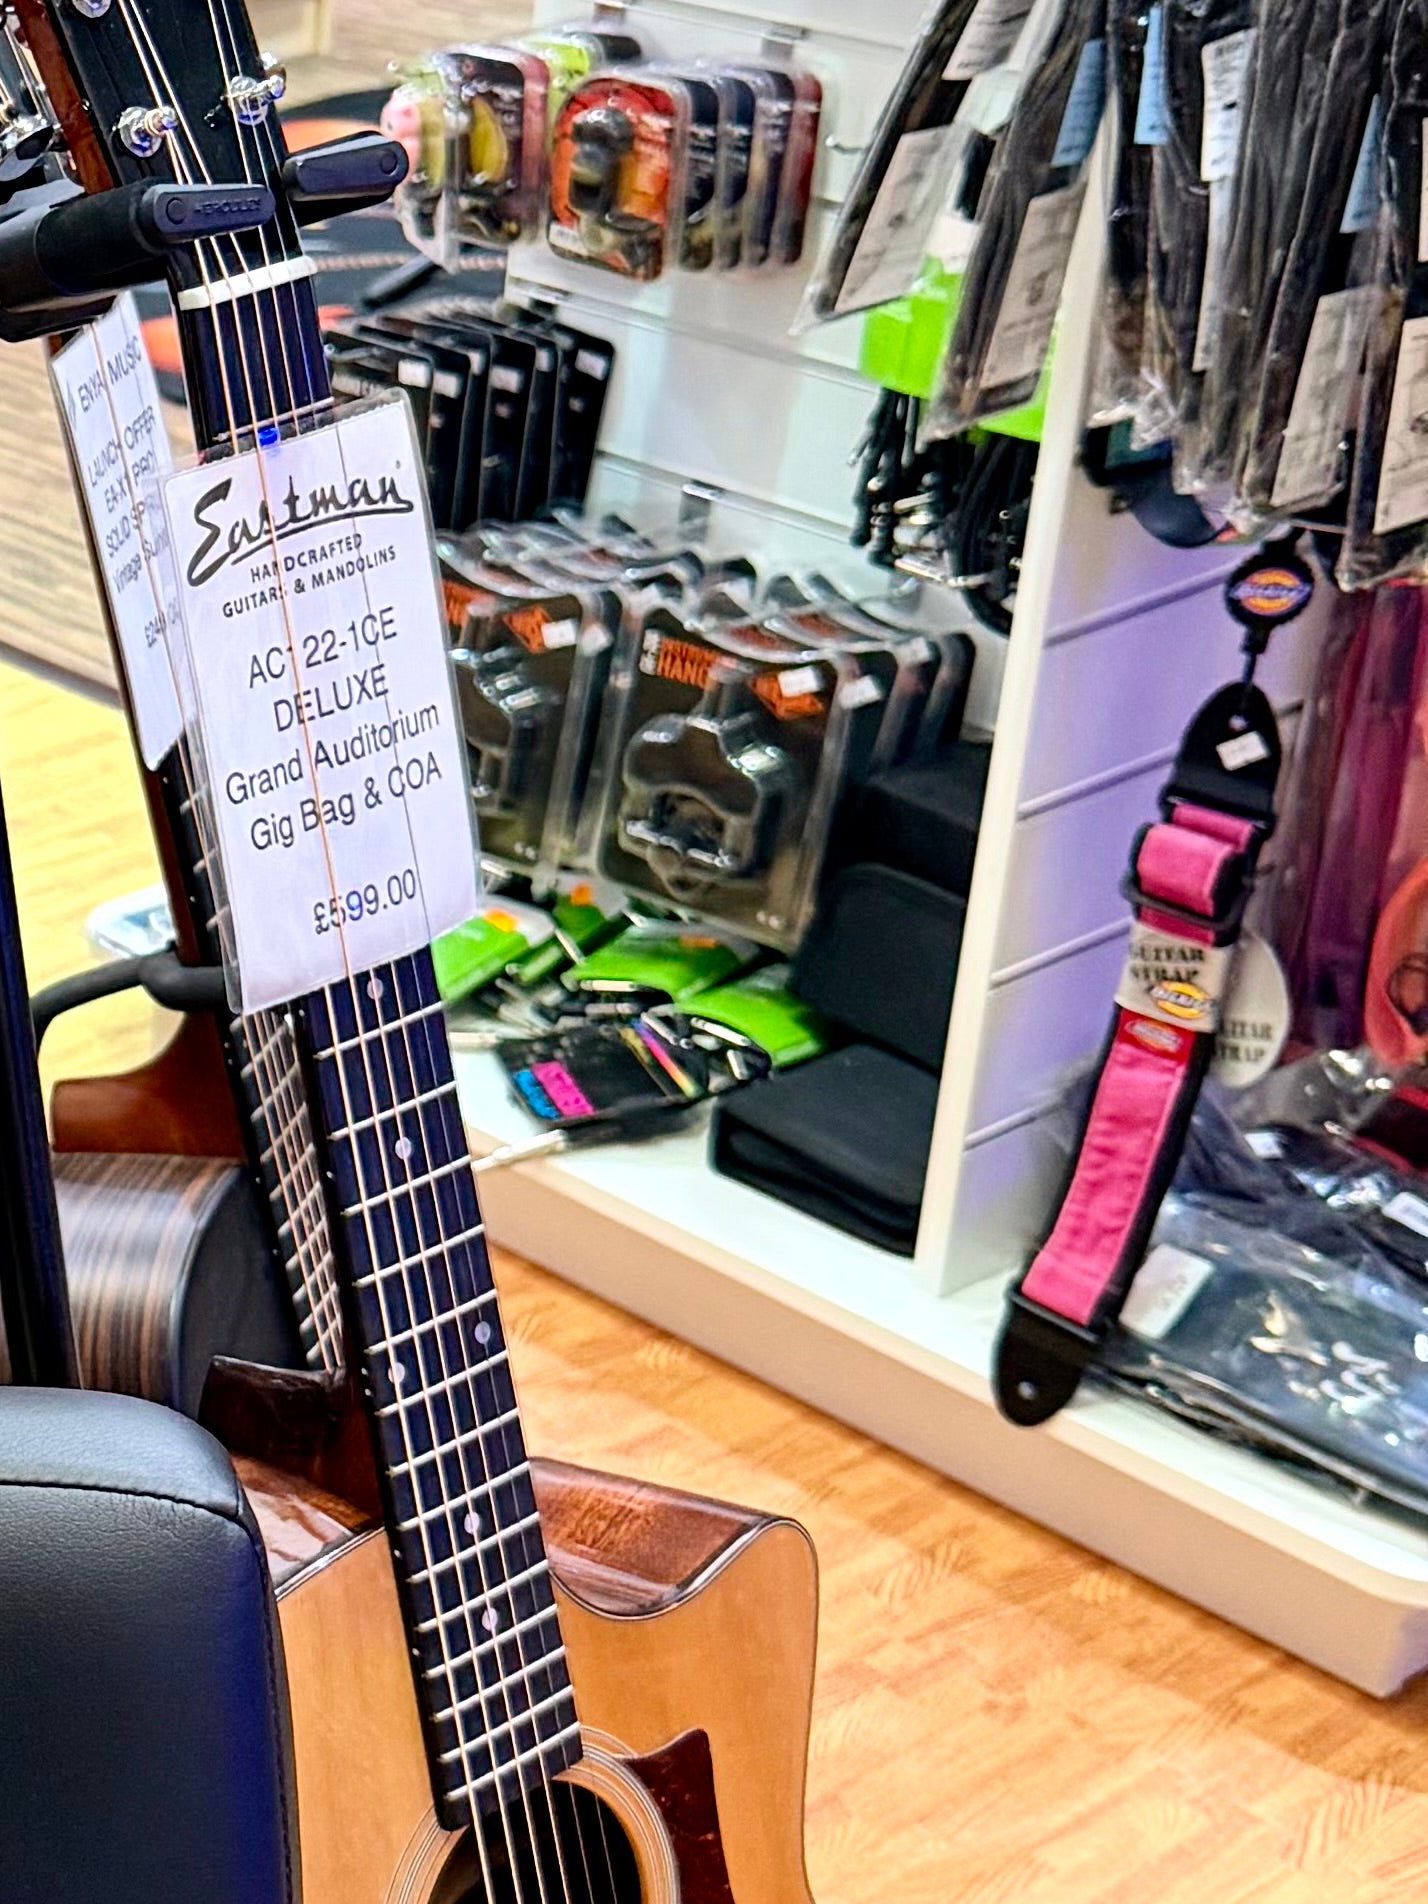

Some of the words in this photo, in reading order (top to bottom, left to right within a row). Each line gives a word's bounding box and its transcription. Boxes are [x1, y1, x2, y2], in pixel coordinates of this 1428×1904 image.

[78, 373, 105, 413] ENYA
[106, 336, 143, 385] MUSIC
[186, 475, 414, 587] Eastman
[251, 533, 362, 583] HANDCRAFTED
[223, 585, 285, 619] GUITARS
[294, 578, 306, 594] &
[311, 545, 396, 590] MANDOLINS
[274, 664, 389, 732] DELUXE
[226, 749, 303, 805] Grand
[315, 704, 439, 771] Auditorium
[251, 813, 294, 850] Gig
[300, 793, 355, 832] Bag
[364, 777, 382, 809] &
[388, 751, 442, 798] COA
[314, 868, 417, 935] £599.00
[1224, 1020, 1272, 1039] ITAR
